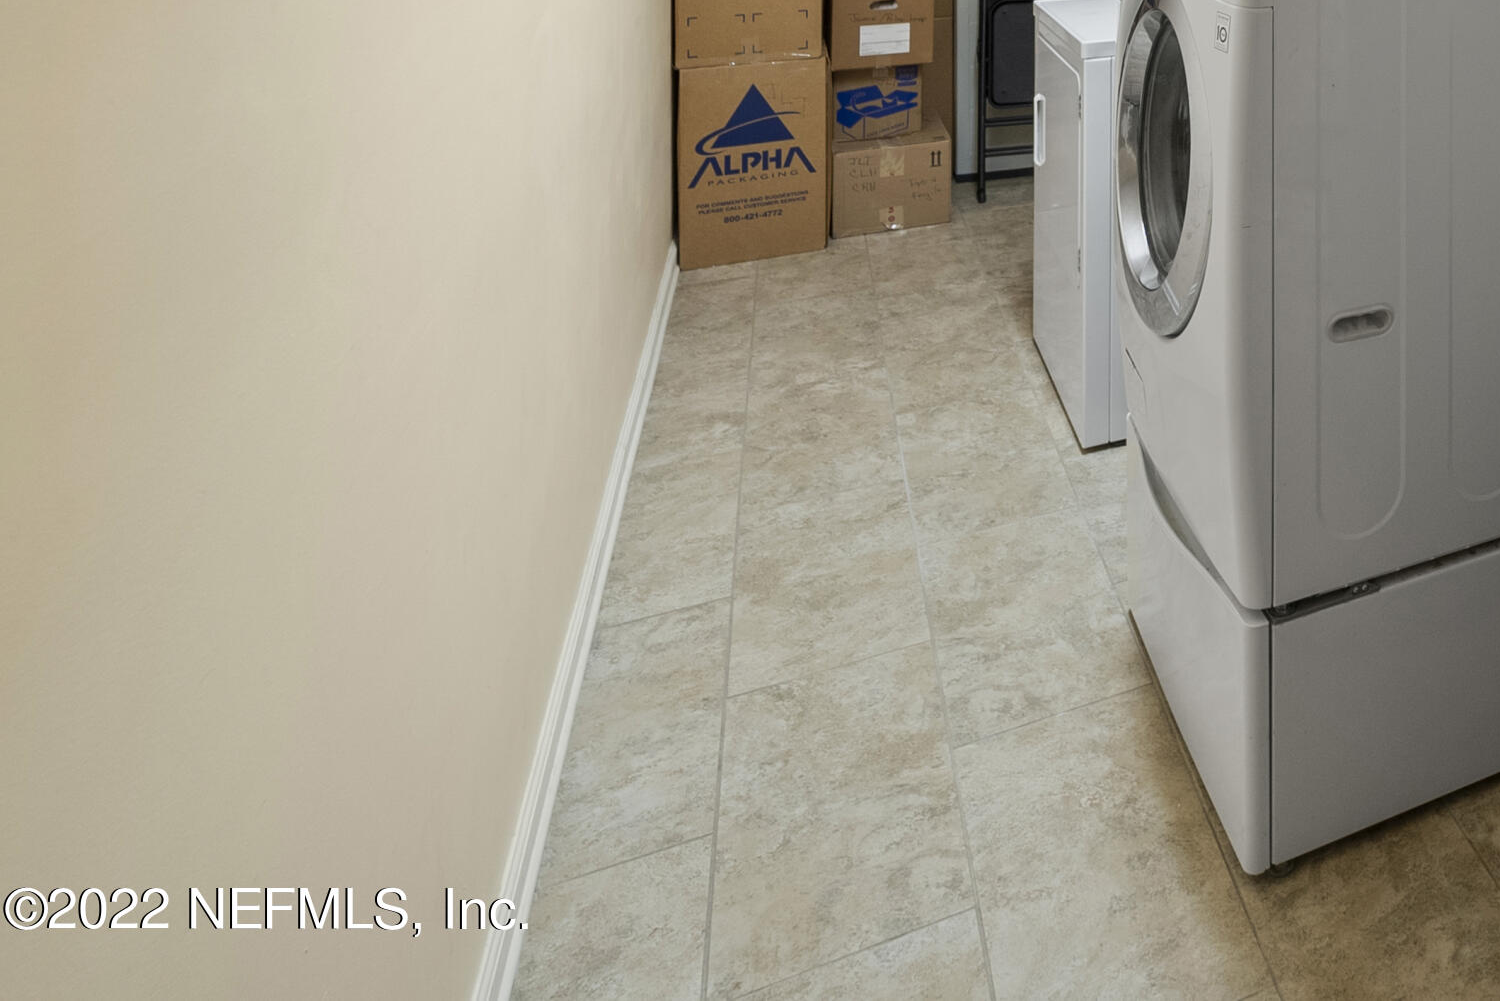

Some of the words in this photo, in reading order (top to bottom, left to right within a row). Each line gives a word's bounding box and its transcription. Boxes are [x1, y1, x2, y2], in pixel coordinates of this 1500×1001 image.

[687, 146, 816, 189] ALPHA
[707, 170, 799, 186] PACKAGING
[723, 209, 783, 224] 800-421-4772
